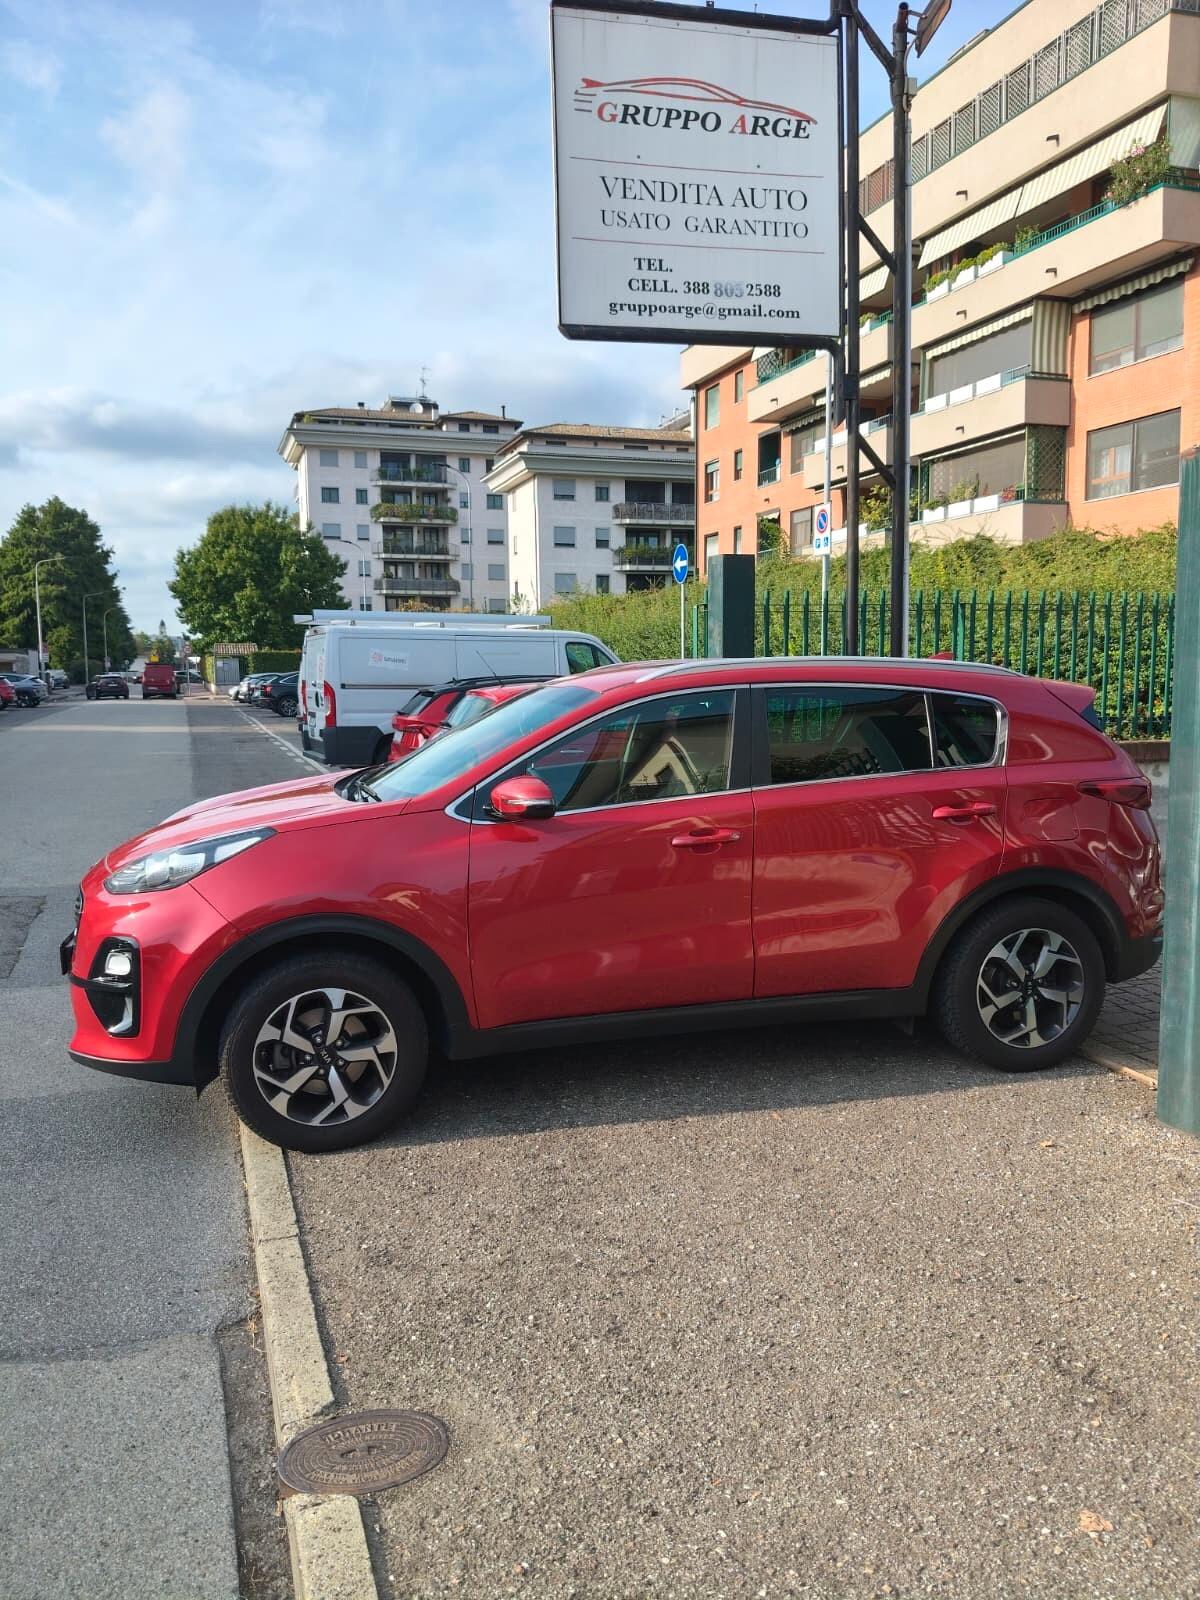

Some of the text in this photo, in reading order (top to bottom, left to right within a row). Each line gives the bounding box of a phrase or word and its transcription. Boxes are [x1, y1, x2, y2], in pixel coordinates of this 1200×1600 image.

[597, 101, 811, 139] GRUPPO ARGE
[600, 175, 808, 211] VENDITA AUTO
[600, 209, 809, 239] USATO GARANTITO
[633, 257, 673, 273] TEL.
[628, 278, 678, 294] CELL.
[683, 281, 710, 295] 388
[746, 283, 782, 297] 2588
[608, 302, 801, 321] gruppoarge@gmail.com
